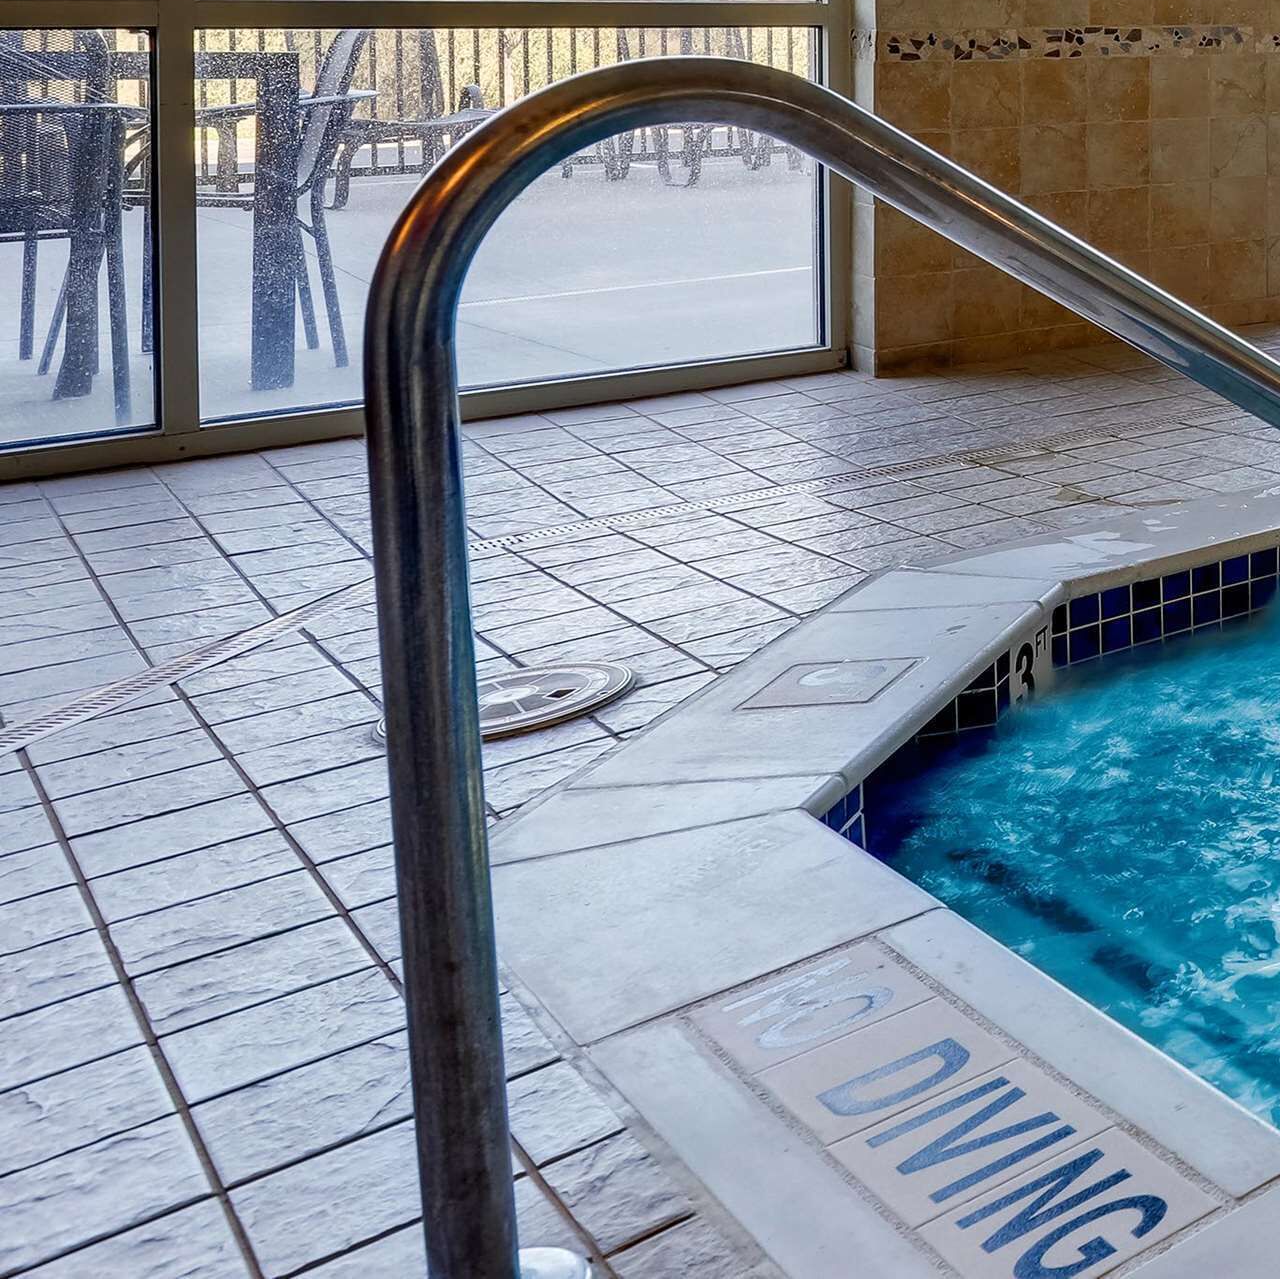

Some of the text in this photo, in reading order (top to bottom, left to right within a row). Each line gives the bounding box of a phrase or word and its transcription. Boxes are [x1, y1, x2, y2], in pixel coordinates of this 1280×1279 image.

[1015, 624, 1049, 702] 3 FT
[815, 1037, 1169, 1279] DIVING
